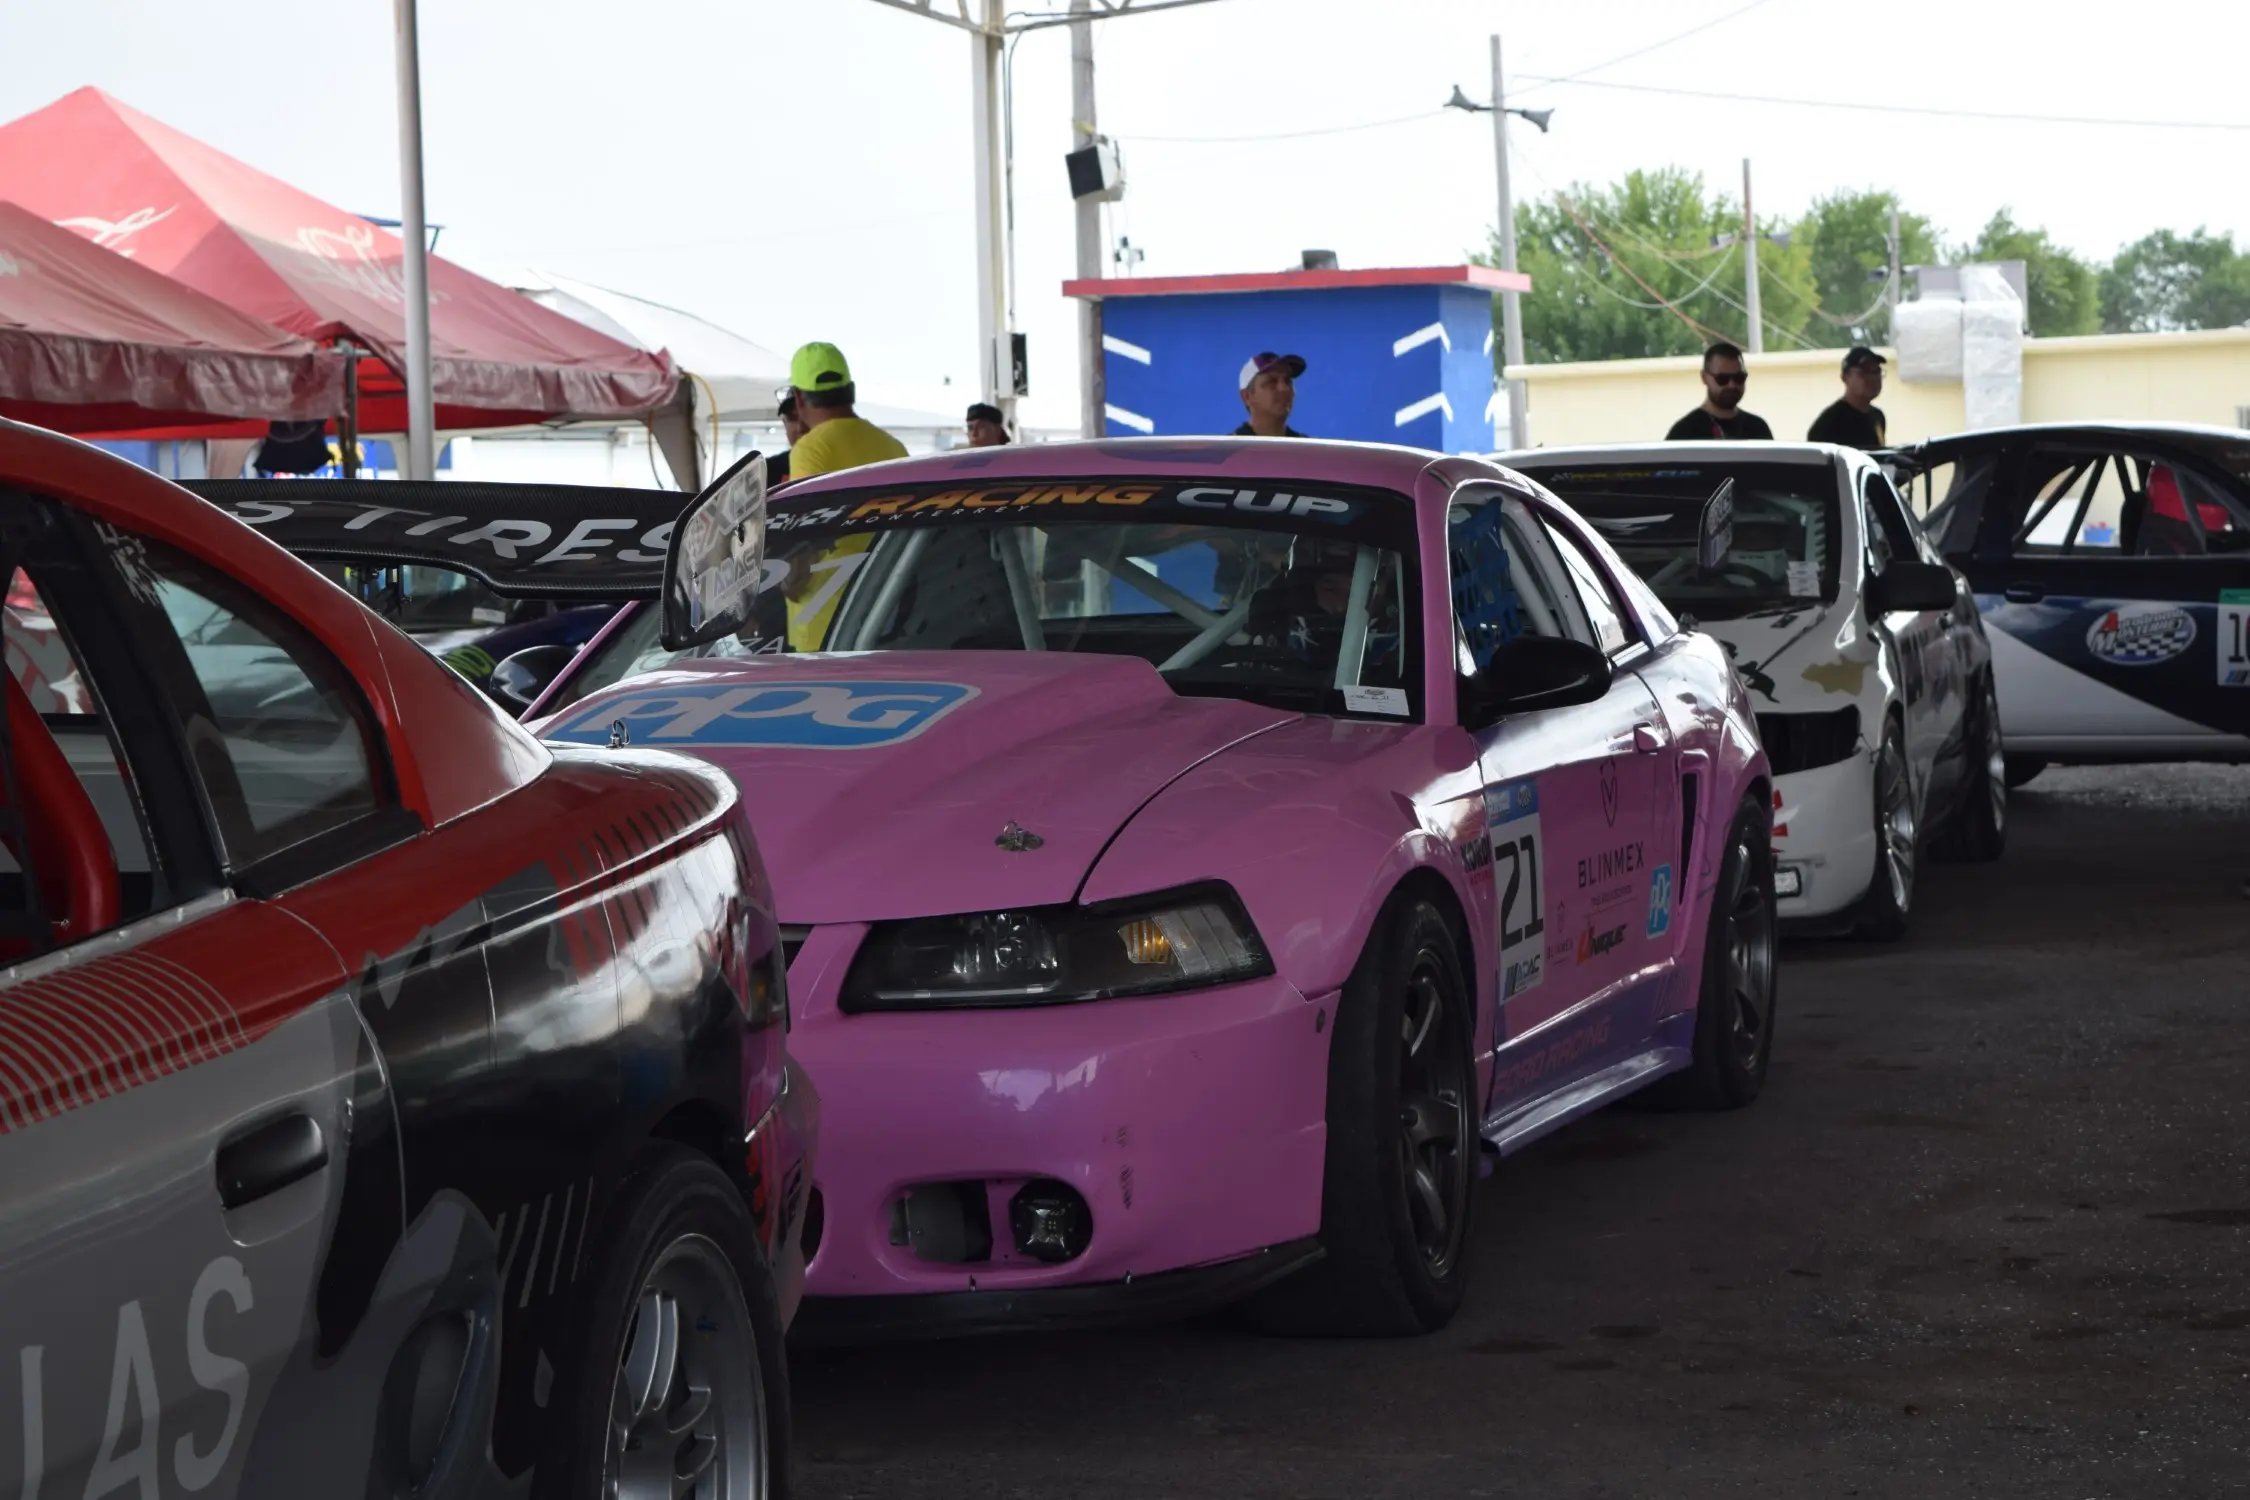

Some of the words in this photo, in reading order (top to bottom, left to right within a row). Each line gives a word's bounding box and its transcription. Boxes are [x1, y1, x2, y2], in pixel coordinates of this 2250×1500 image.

[841, 504, 1031, 527] MONTERREY
[851, 485, 1165, 518] RACING
[1176, 487, 1352, 516] CUP
[343, 503, 674, 564] TIRES
[2228, 612, 2250, 663] 1
[570, 686, 944, 738] PPG
[1577, 840, 1645, 888] BLINMEX
[1495, 834, 1544, 951] 21
